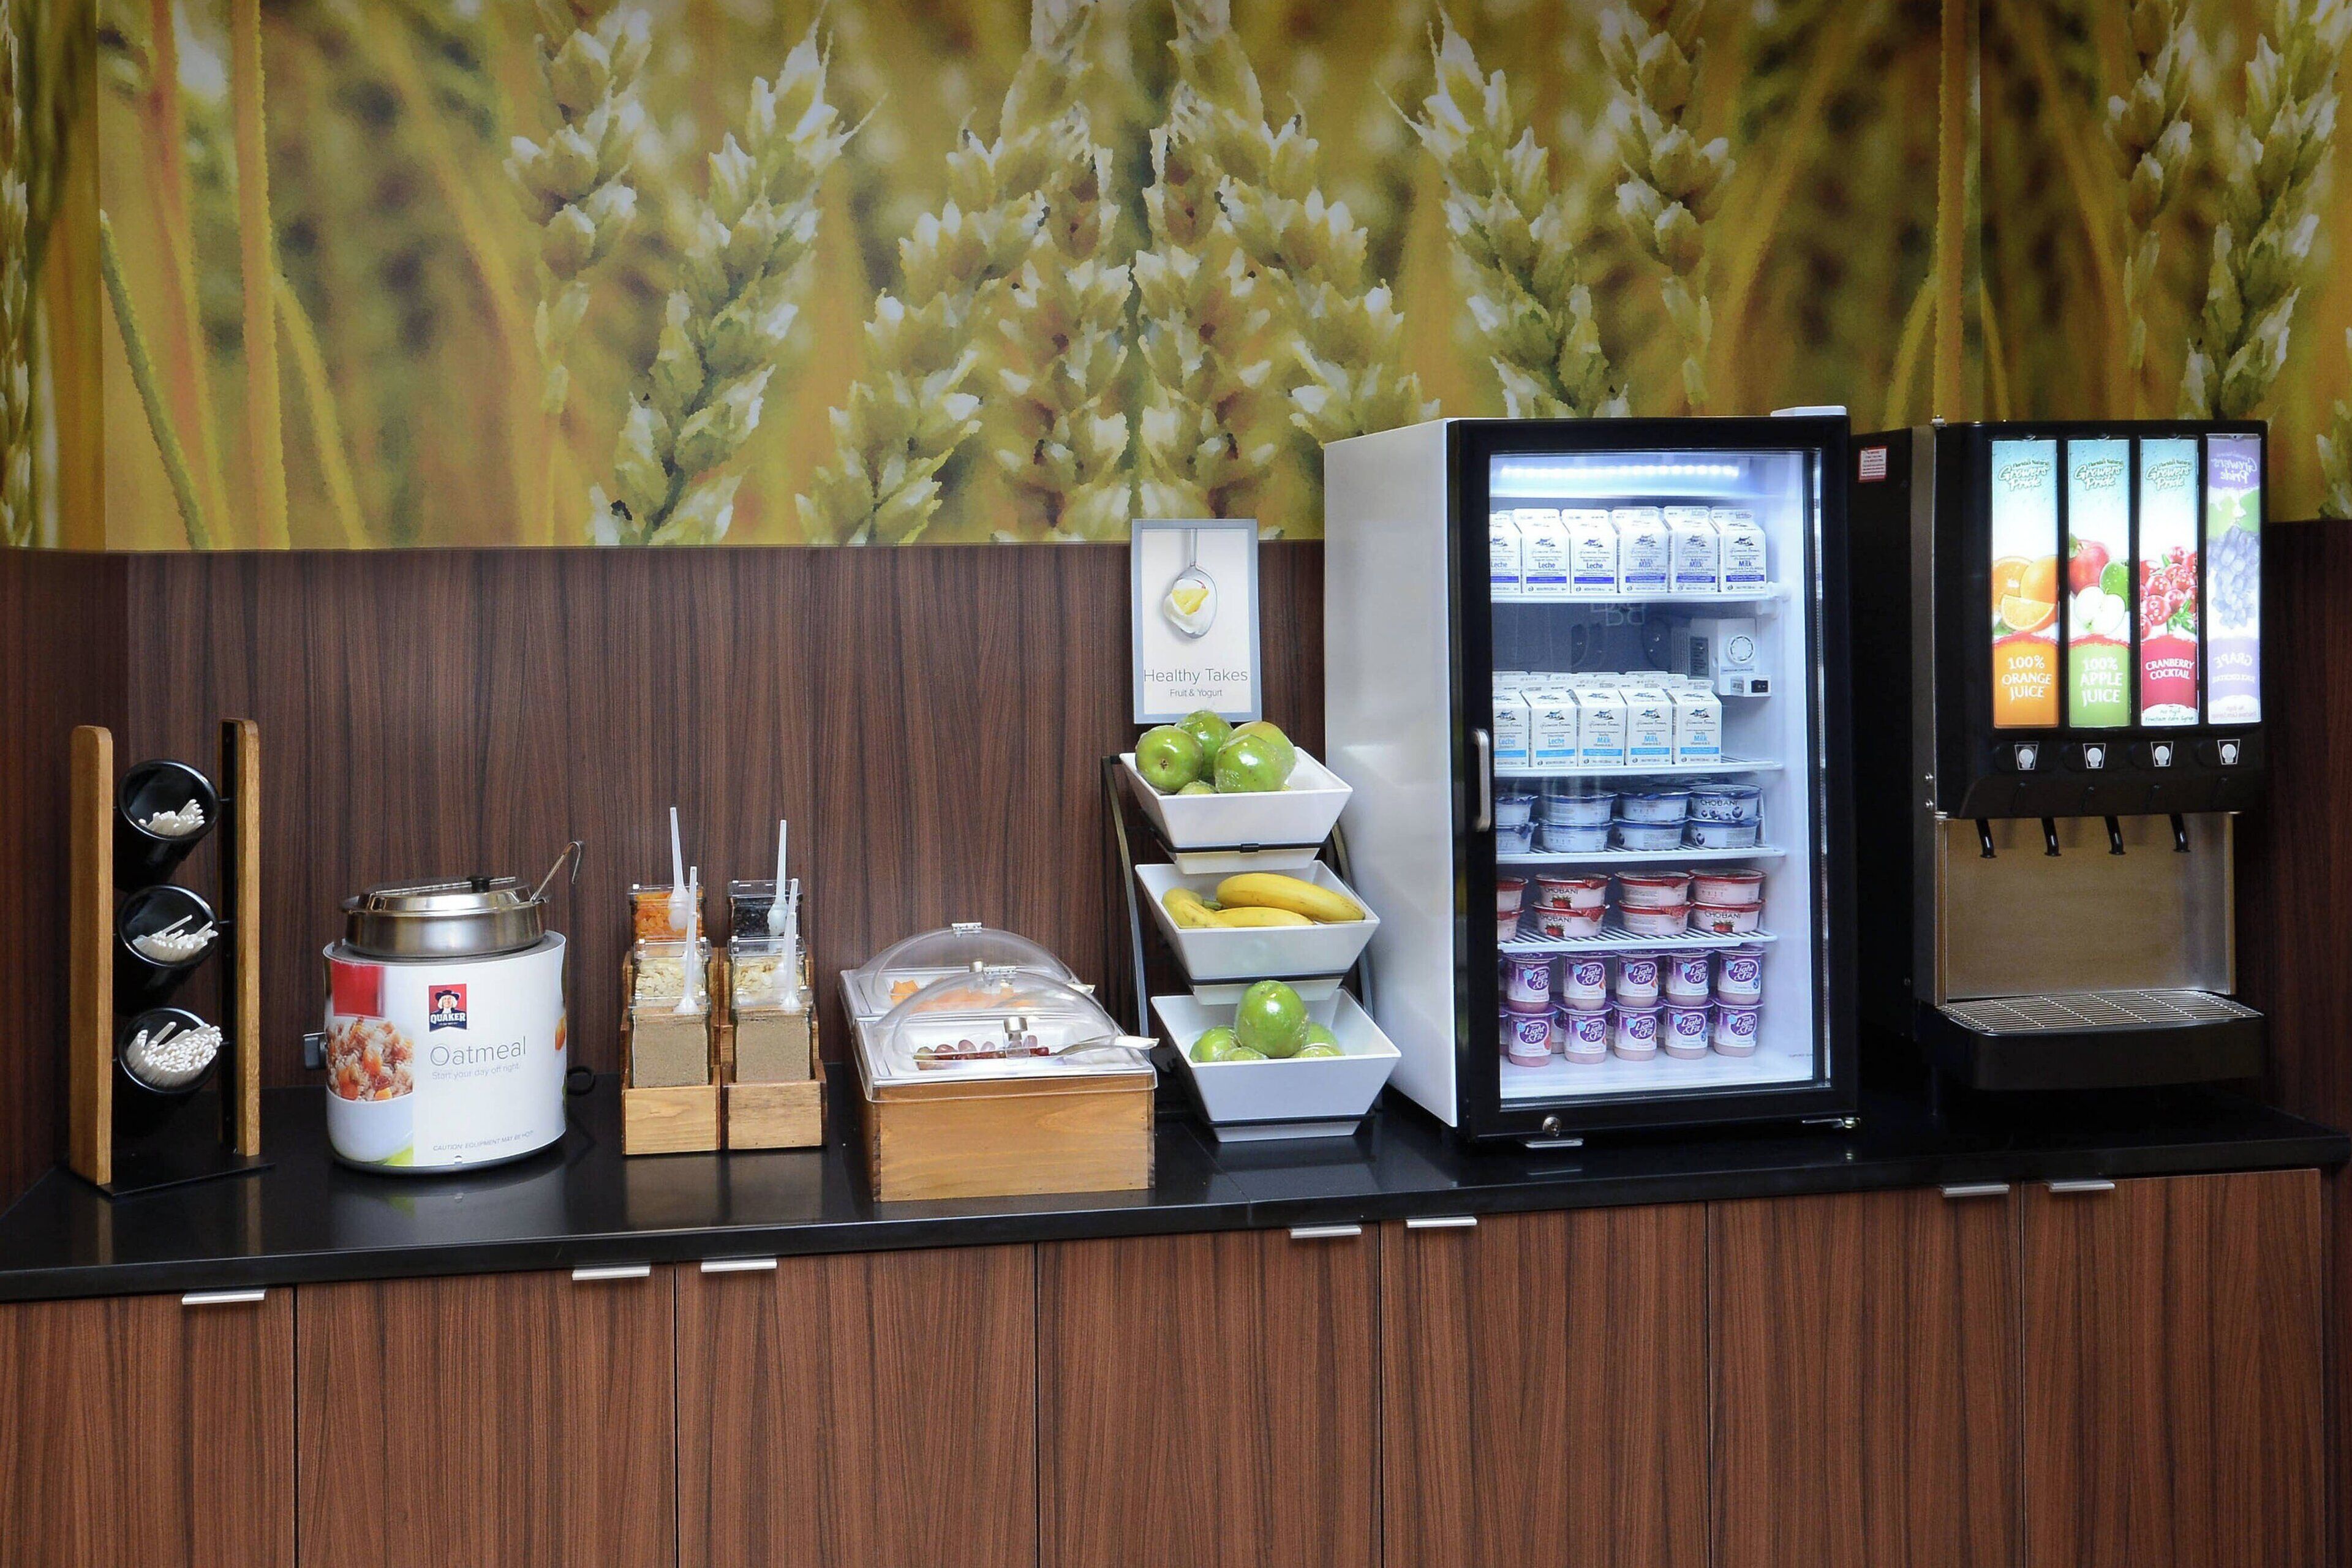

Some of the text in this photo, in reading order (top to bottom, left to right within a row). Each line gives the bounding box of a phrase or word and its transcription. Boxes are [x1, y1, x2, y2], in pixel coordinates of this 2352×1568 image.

[2008, 477, 2041, 491] Pride
[2085, 475, 2116, 490] Pride
[2155, 476, 2184, 491] Pride
[2008, 655, 2045, 669] 100%
[2084, 657, 2118, 671] 100%
[2146, 658, 2195, 670] CRANBERRY
[1144, 668, 1248, 685] Healthy Takes
[2001, 673, 2052, 685] ORANGE
[2080, 673, 2124, 687] APPLE
[2149, 668, 2190, 680] COCKTAIL
[1197, 689, 1223, 698] Yogurt
[2010, 685, 2045, 701] JUICE
[2082, 688, 2120, 707] JUICE
[1581, 966, 1601, 977] Light
[1634, 966, 1653, 976] Light
[1733, 963, 1754, 974] Light
[430, 1012, 466, 1024] QUAKER
[1682, 1017, 1701, 1027] Light
[1736, 1017, 1754, 1028] Light
[1525, 1025, 1545, 1035] Light
[430, 1036, 526, 1066] Oatmeal
[432, 1071, 451, 1080] Start
[465, 1139, 500, 1148] EQUIPMENT
